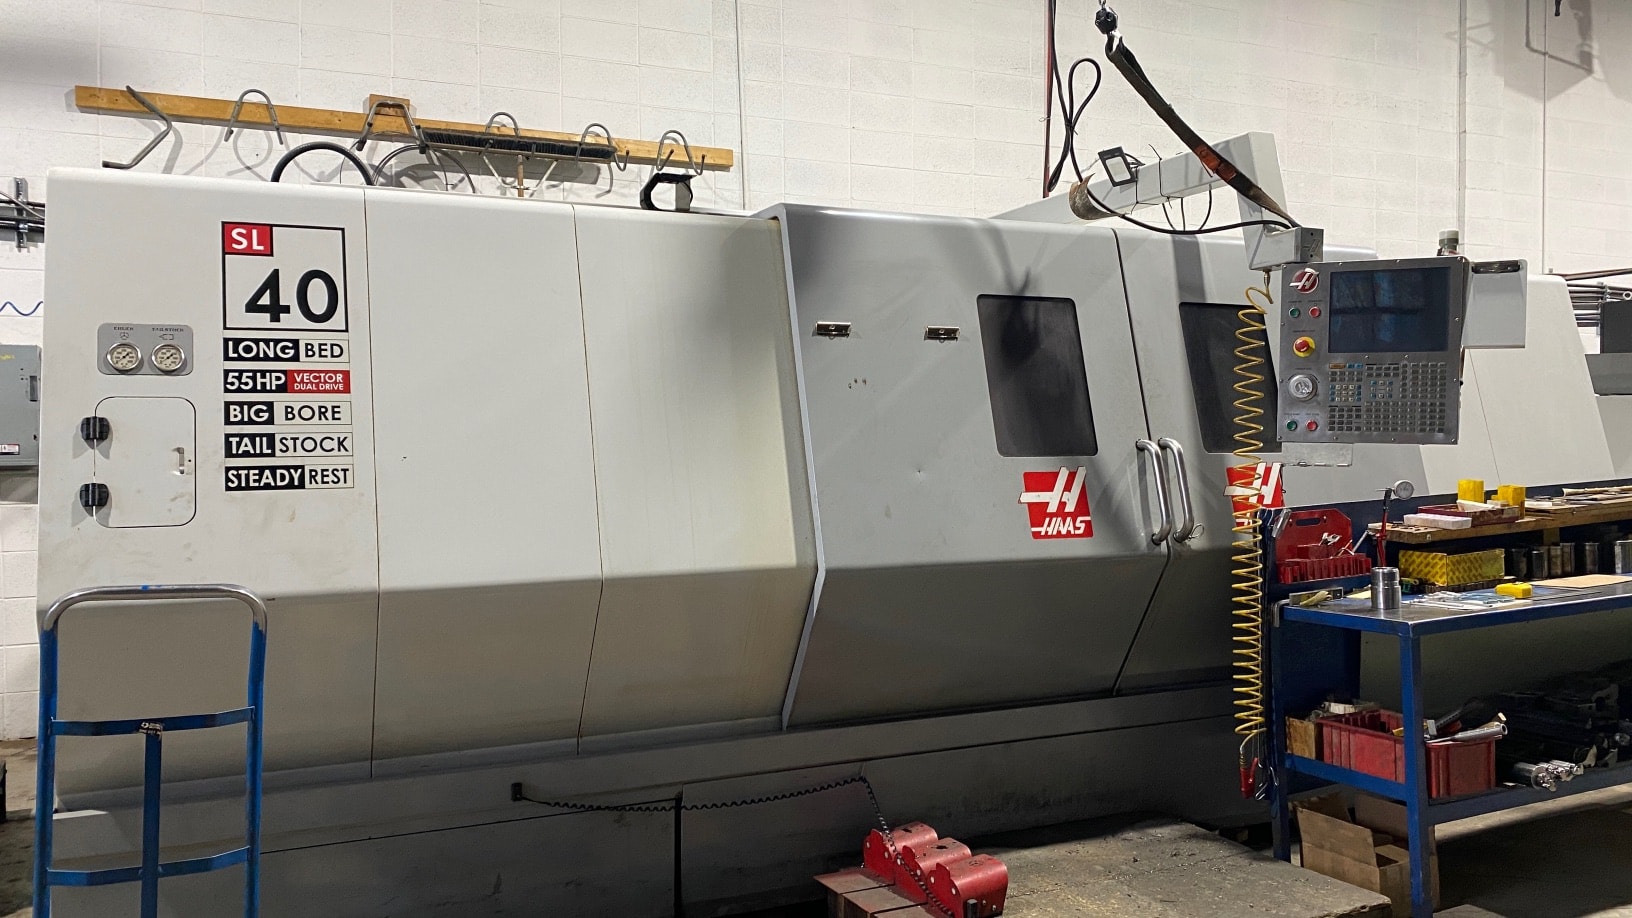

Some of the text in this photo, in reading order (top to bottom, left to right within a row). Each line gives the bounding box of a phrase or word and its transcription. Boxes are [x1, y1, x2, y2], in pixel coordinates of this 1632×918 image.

[231, 228, 265, 251] SL
[245, 268, 339, 324] 40
[228, 341, 344, 359] LONG BED
[293, 372, 344, 383] VECTOR
[294, 383, 344, 391] DUAL DRIVE
[229, 404, 342, 422] BIG BORE
[228, 436, 350, 454] TAIL STOCK
[227, 468, 350, 487] STEADY REST
[1031, 516, 1092, 536] HAAS
